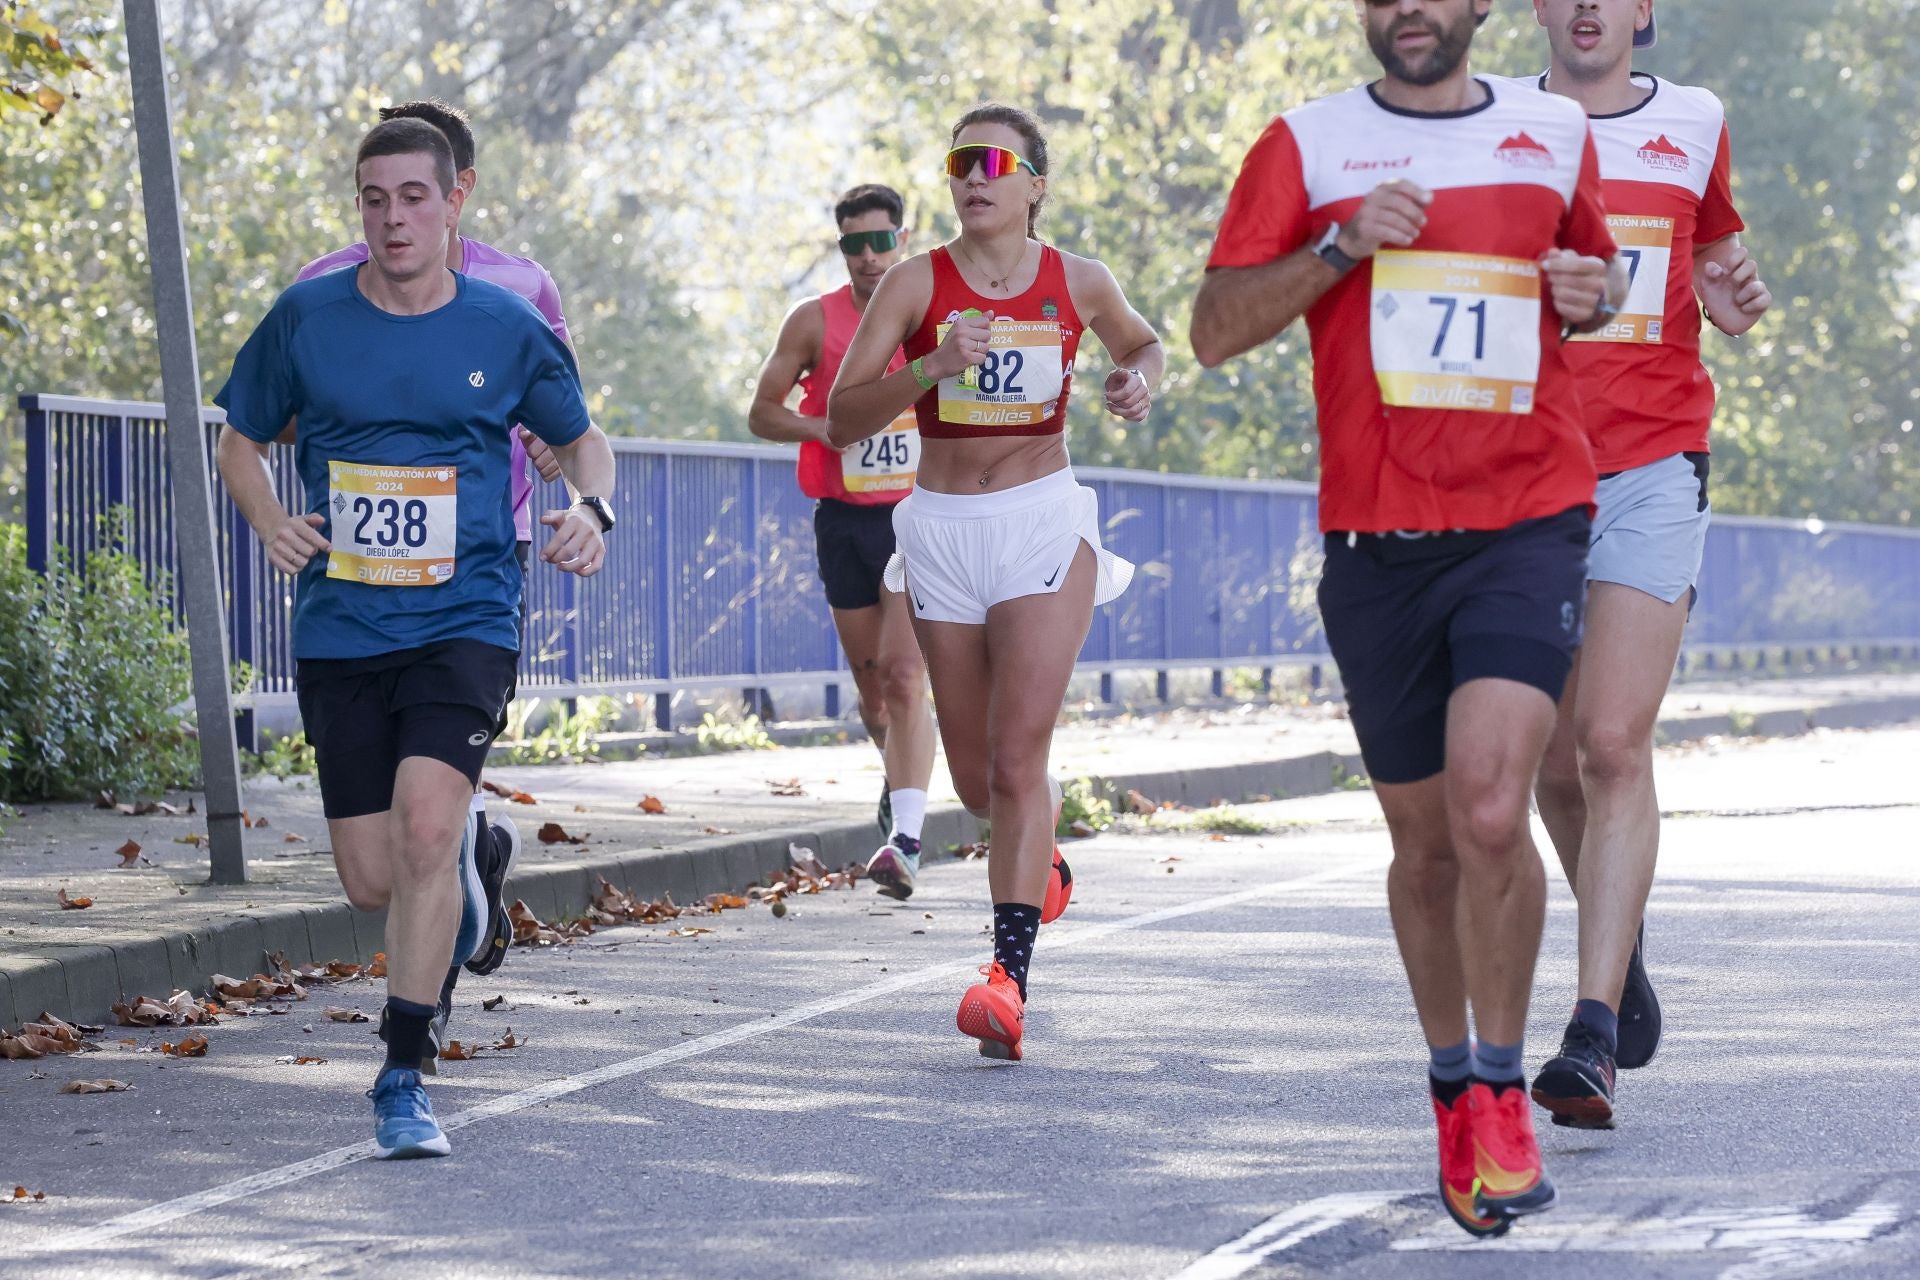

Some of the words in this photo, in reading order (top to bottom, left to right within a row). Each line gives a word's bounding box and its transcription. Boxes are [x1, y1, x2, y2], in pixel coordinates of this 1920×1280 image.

[1342, 155, 1413, 172] land
[1643, 158, 1666, 166] TRAIL
[1669, 160, 1688, 170] TEAM
[1606, 216, 1639, 228] RATÓN
[1640, 217, 1670, 229] AVILÉS
[1619, 249, 1641, 292] 7
[990, 323, 1031, 333] MARATÓN
[1032, 322, 1058, 332] AVILÉS
[1429, 296, 1487, 360] 71
[978, 350, 1024, 395] 82
[975, 393, 1001, 402] MARINA
[1001, 394, 1027, 403] GUERRA
[968, 408, 1033, 424] avilés
[860, 433, 909, 468] 245
[353, 467, 379, 479] MEDIA
[380, 468, 425, 480] MARATÓN
[375, 481, 404, 491] 2024
[353, 496, 428, 548] 238
[366, 547, 386, 558] DIEGO
[387, 546, 410, 558] LÓPEZ
[358, 564, 422, 582] avilés
